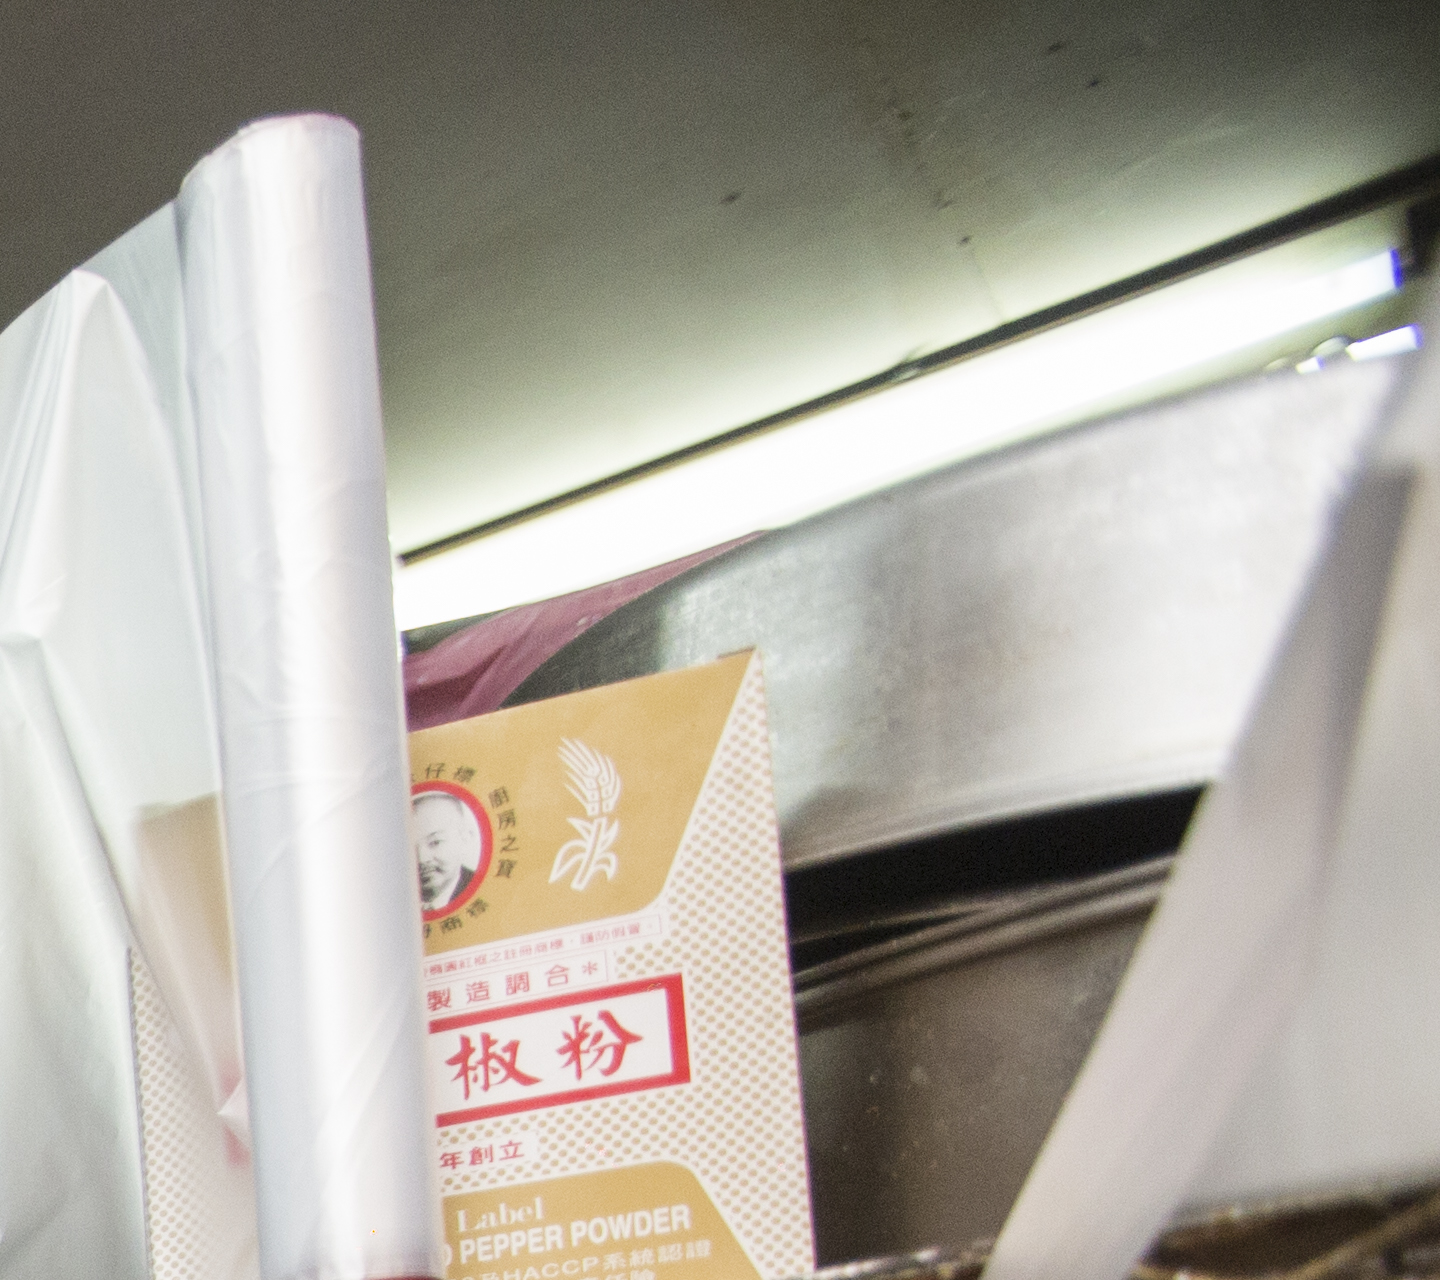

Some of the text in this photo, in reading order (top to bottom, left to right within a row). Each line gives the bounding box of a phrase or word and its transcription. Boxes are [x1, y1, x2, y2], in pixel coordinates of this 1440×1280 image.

[444, 1010, 643, 1101] 椒粉
[439, 1140, 525, 1169] 年創立
[457, 1196, 545, 1234] Label
[459, 1224, 564, 1265] PEPPER
[569, 1203, 693, 1247] POWDER
